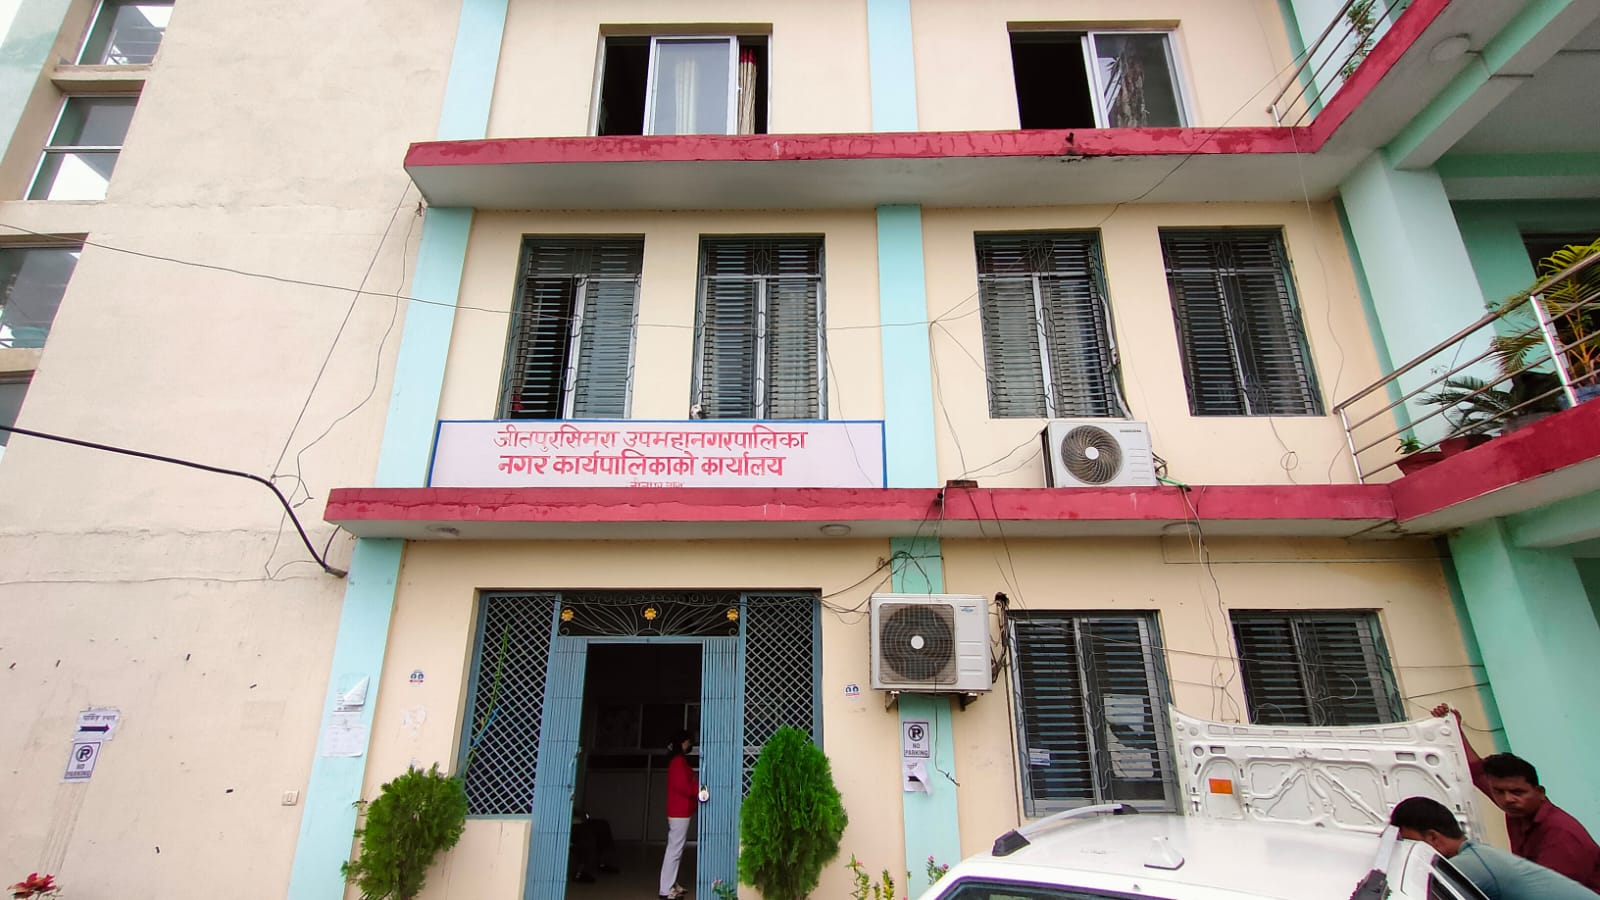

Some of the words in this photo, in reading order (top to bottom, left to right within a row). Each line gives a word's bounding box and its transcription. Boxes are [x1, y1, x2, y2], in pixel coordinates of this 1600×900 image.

[493, 423, 619, 452] जीतपुरसिमरा
[623, 424, 809, 451] उपमहानगरपालिका
[498, 455, 551, 475] नगर
[552, 448, 699, 476] कार्यपालिकाको
[701, 451, 787, 476] कार्यालय
